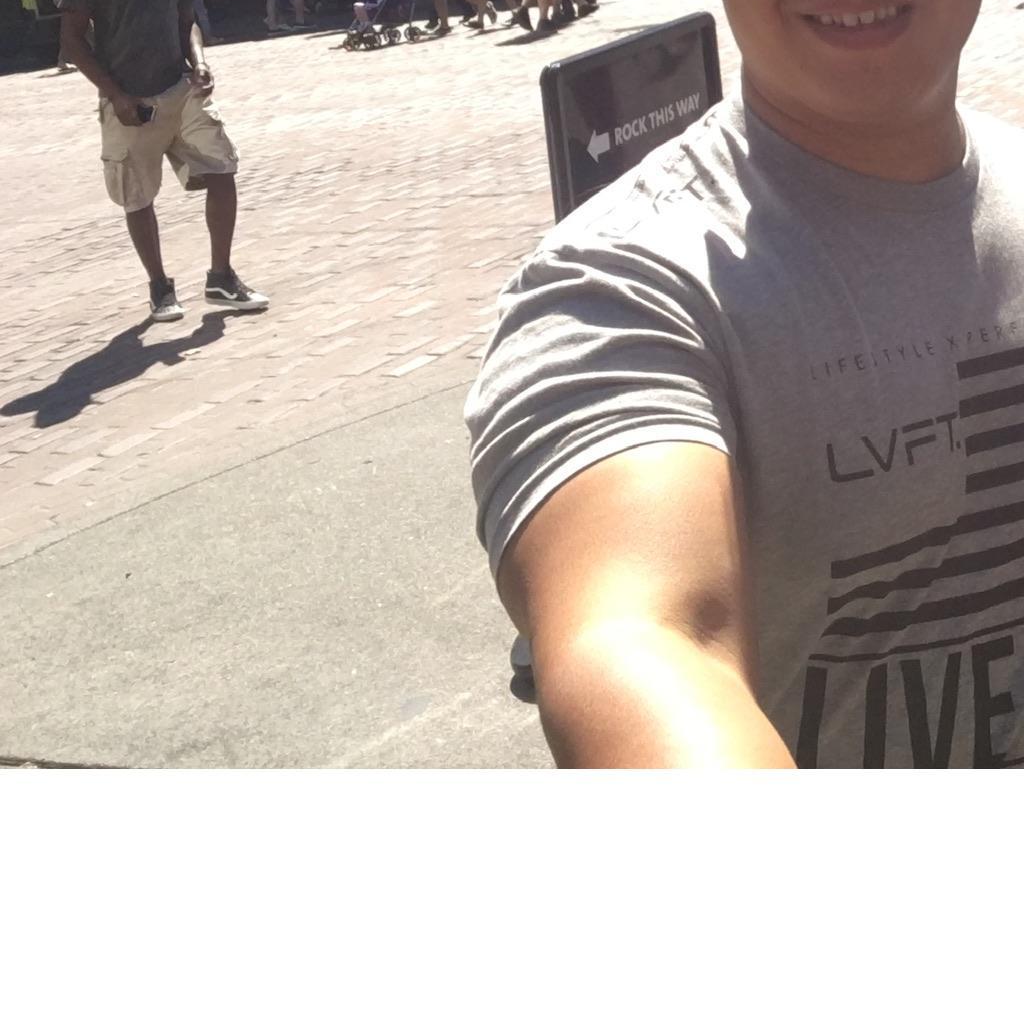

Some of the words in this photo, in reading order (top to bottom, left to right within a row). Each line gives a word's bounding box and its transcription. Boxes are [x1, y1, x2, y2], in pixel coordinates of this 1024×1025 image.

[614, 116, 649, 146] ROCK
[648, 102, 676, 132] THIS
[676, 92, 701, 118] WAY
[810, 340, 935, 381] LIFESTYLE
